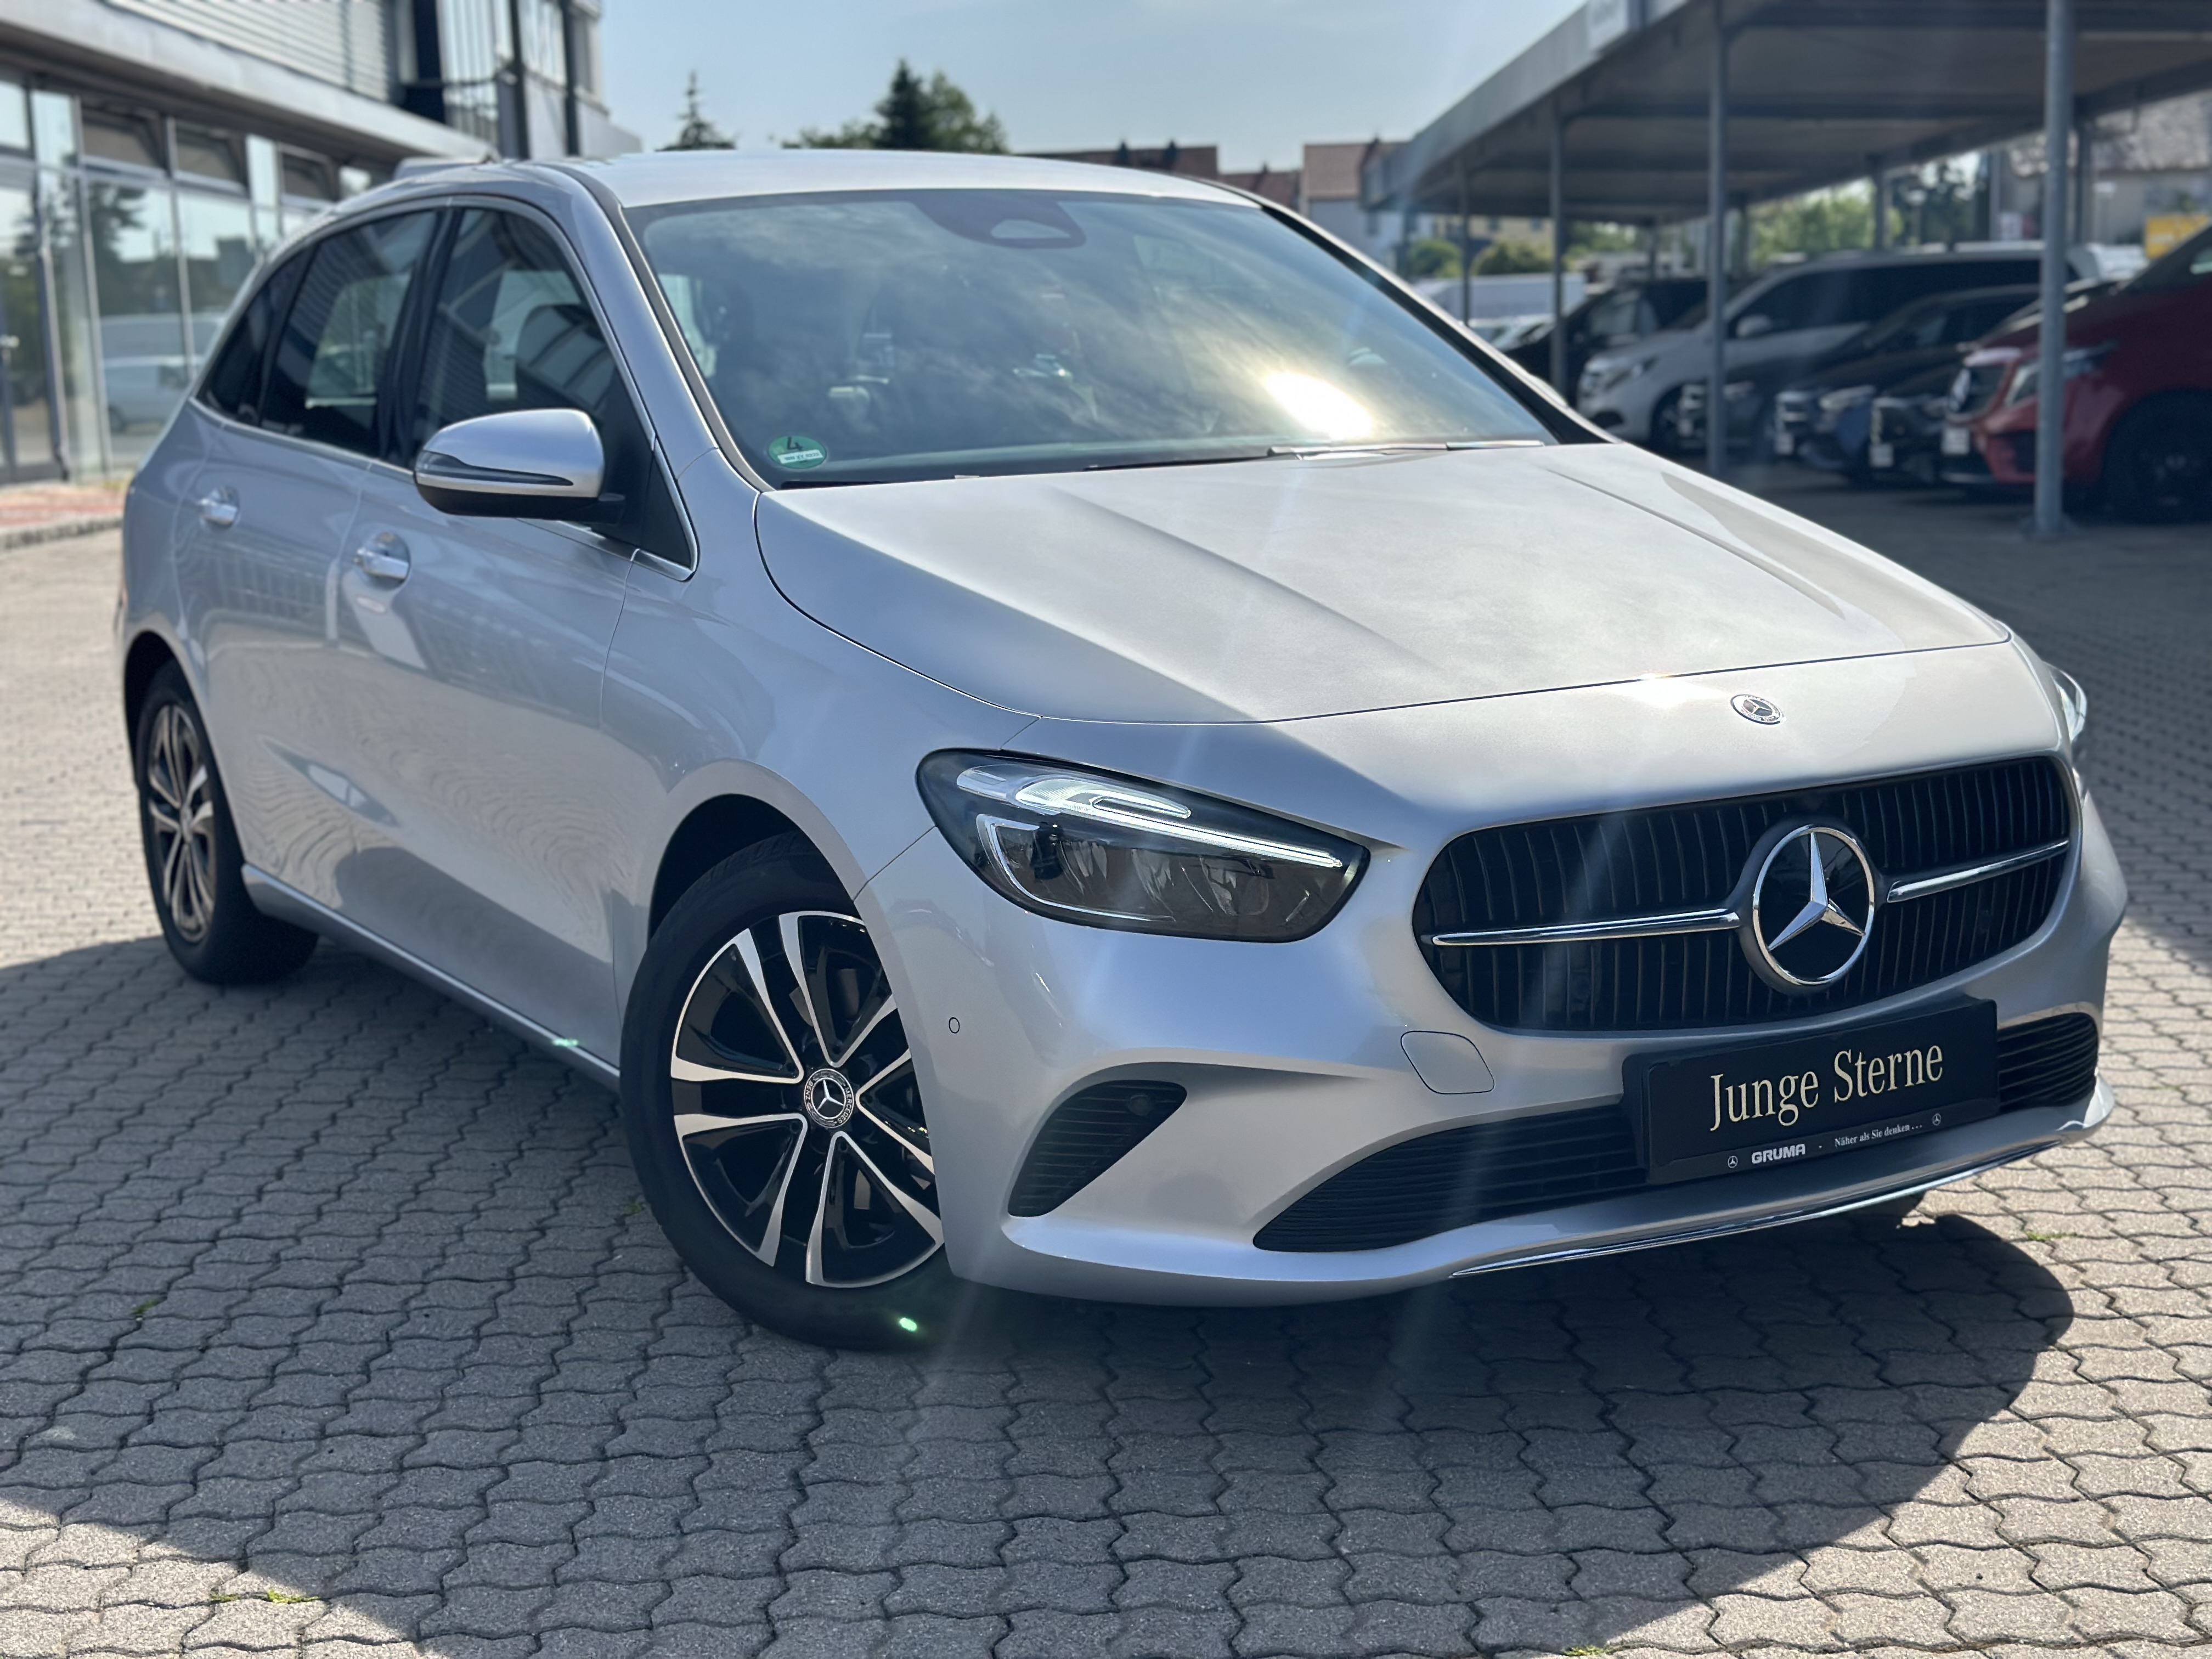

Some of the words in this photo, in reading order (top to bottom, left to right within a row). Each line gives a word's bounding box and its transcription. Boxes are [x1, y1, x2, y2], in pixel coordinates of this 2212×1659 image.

[787, 436, 803, 451] 4
[805, 1080, 814, 1101] BENZ
[837, 1087, 853, 1124] MERCEDES
[1710, 1071, 1819, 1131] Junge
[1834, 1045, 1943, 1103] Sterne
[1751, 1143, 1805, 1164] GRUMA
[1835, 1136, 1858, 1148] Näher
[1859, 1132, 1870, 1142] als
[1871, 1129, 1883, 1139] Sie
